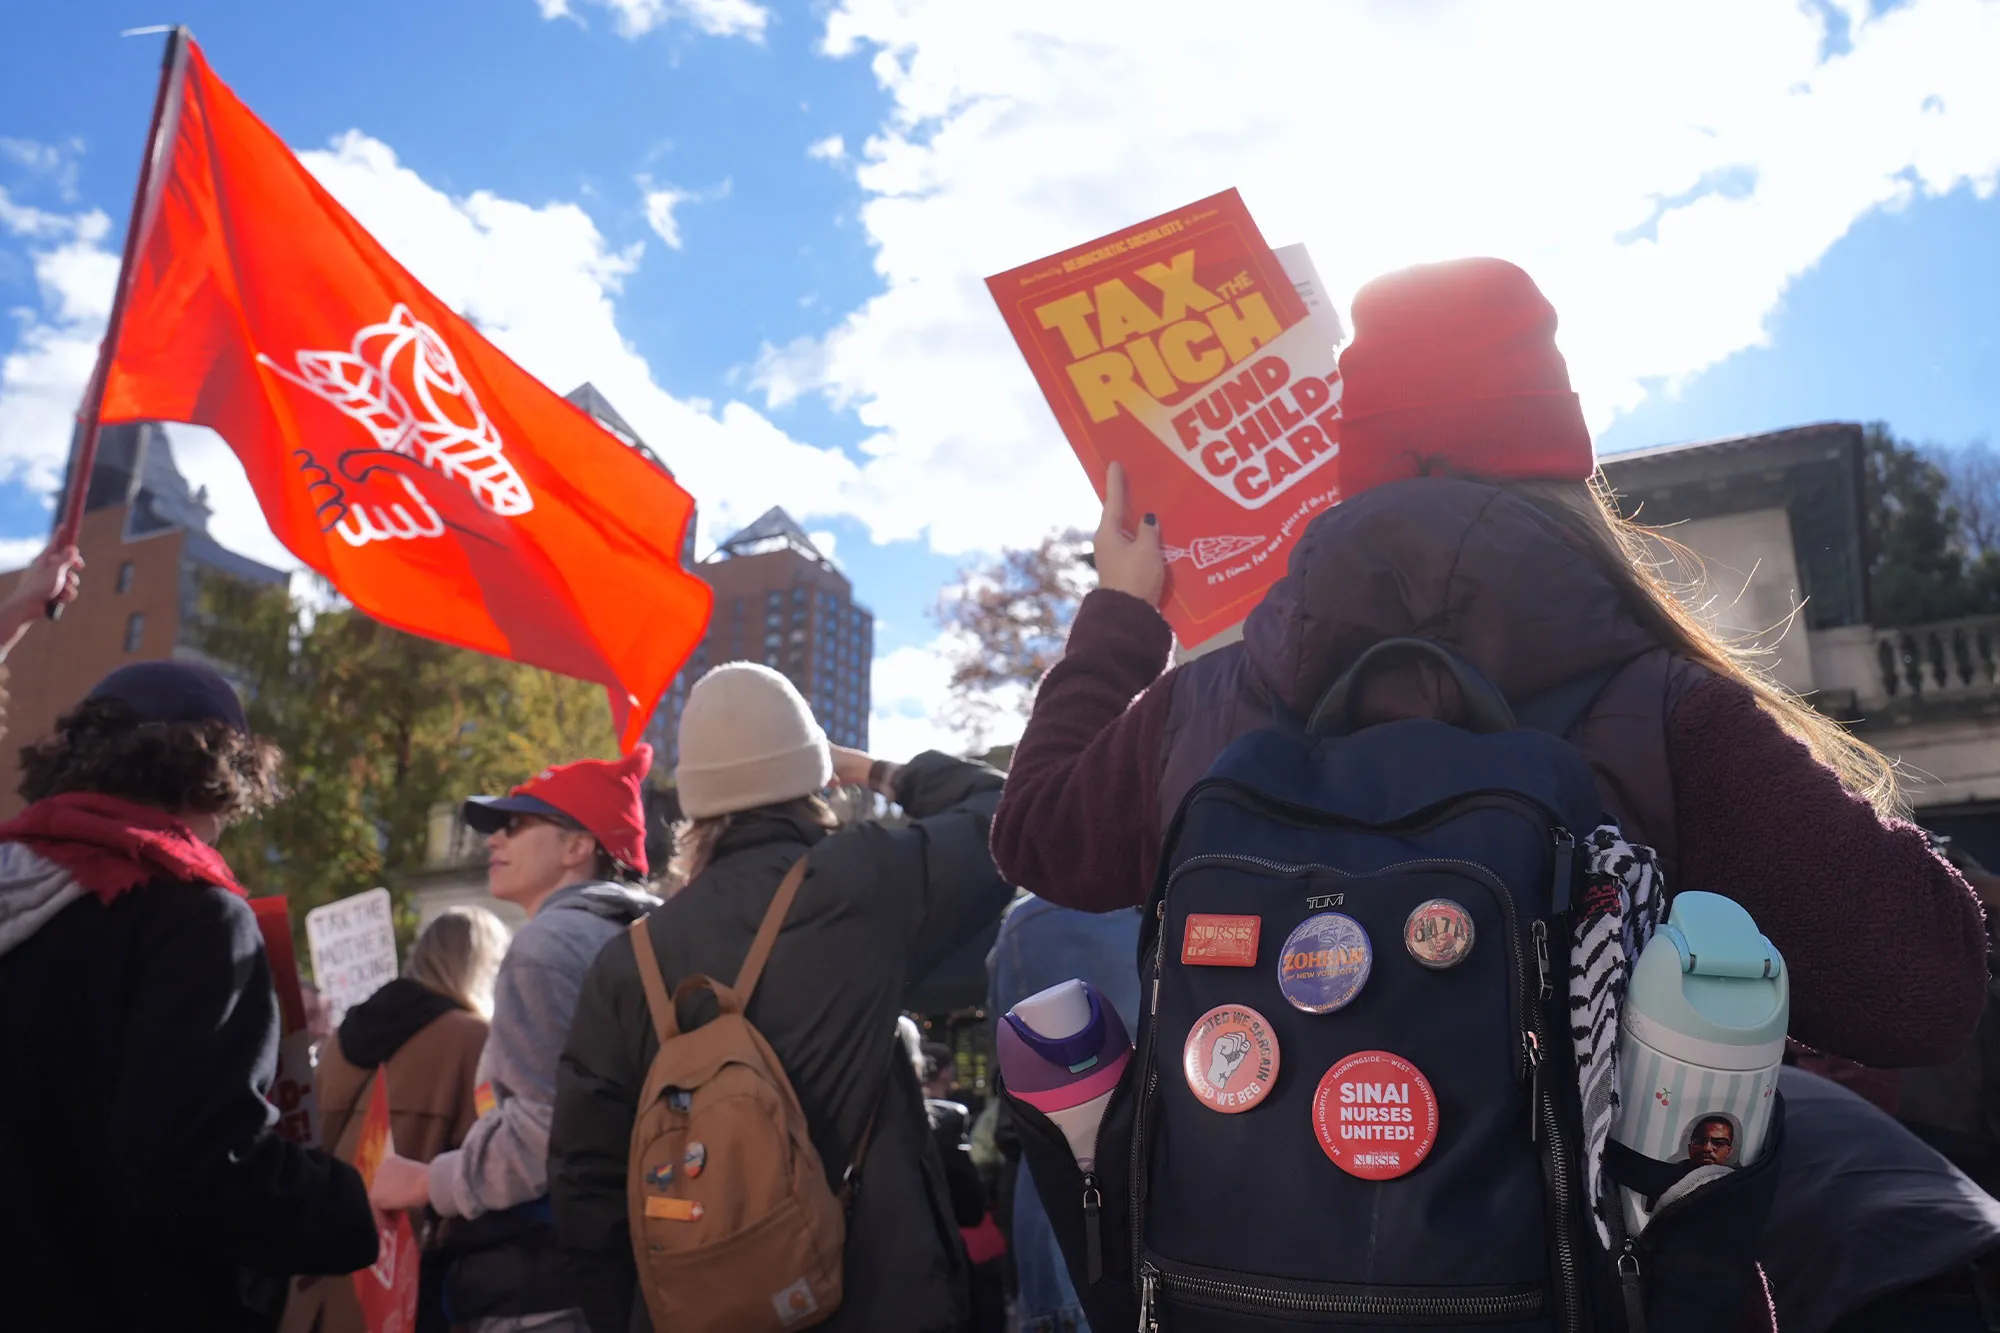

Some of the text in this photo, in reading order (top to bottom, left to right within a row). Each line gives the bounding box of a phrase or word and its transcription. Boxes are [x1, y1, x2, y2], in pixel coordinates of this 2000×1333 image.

[1216, 270, 1254, 300] THE
[1034, 249, 1223, 360] TAX
[1066, 291, 1283, 423] RICH
[1171, 355, 1291, 452] FUND
[1201, 371, 1340, 477] CHILD-
[1306, 893, 1345, 909] TUMI
[314, 911, 352, 937] TAX
[1191, 926, 1252, 940] NURSES
[1282, 946, 1365, 973] ZOHRAN
[1296, 971, 1315, 979] NEW
[1317, 969, 1339, 977] YORK
[1339, 966, 1359, 975] CITY
[1233, 1011, 1251, 1027] WE
[1250, 1021, 1272, 1082] BARGAIN
[1332, 1056, 1380, 1079] MORNINGSIDE
[1391, 1059, 1410, 1073] WEST
[1216, 1092, 1236, 1106] WE
[1237, 1082, 1261, 1104] BEG
[1340, 1082, 1409, 1104] SINAI
[1414, 1076, 1436, 1132] SOUTH NASSAU
[1319, 1087, 1341, 1156] MT. SINAI HOSPITAL
[1340, 1107, 1412, 1122] NURSES
[1340, 1125, 1415, 1140] UNITED!
[1354, 1154, 1400, 1165] NURSES
[1414, 1140, 1429, 1158] NYEE
